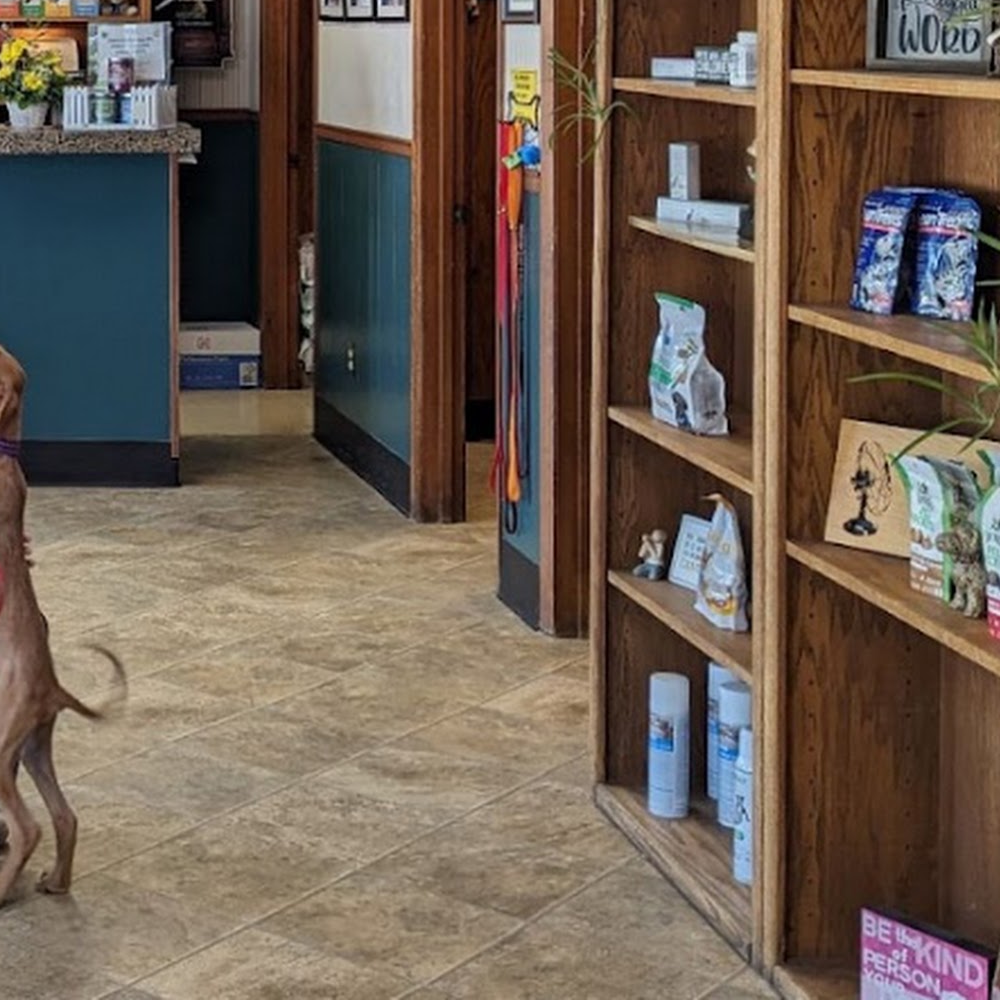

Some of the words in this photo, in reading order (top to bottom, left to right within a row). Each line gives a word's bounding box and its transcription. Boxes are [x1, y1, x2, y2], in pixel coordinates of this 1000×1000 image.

[899, 13, 982, 55] WORD
[862, 911, 893, 945] BE
[915, 940, 984, 990] KIND
[862, 947, 941, 996] PERSON
[891, 948, 909, 963] of
